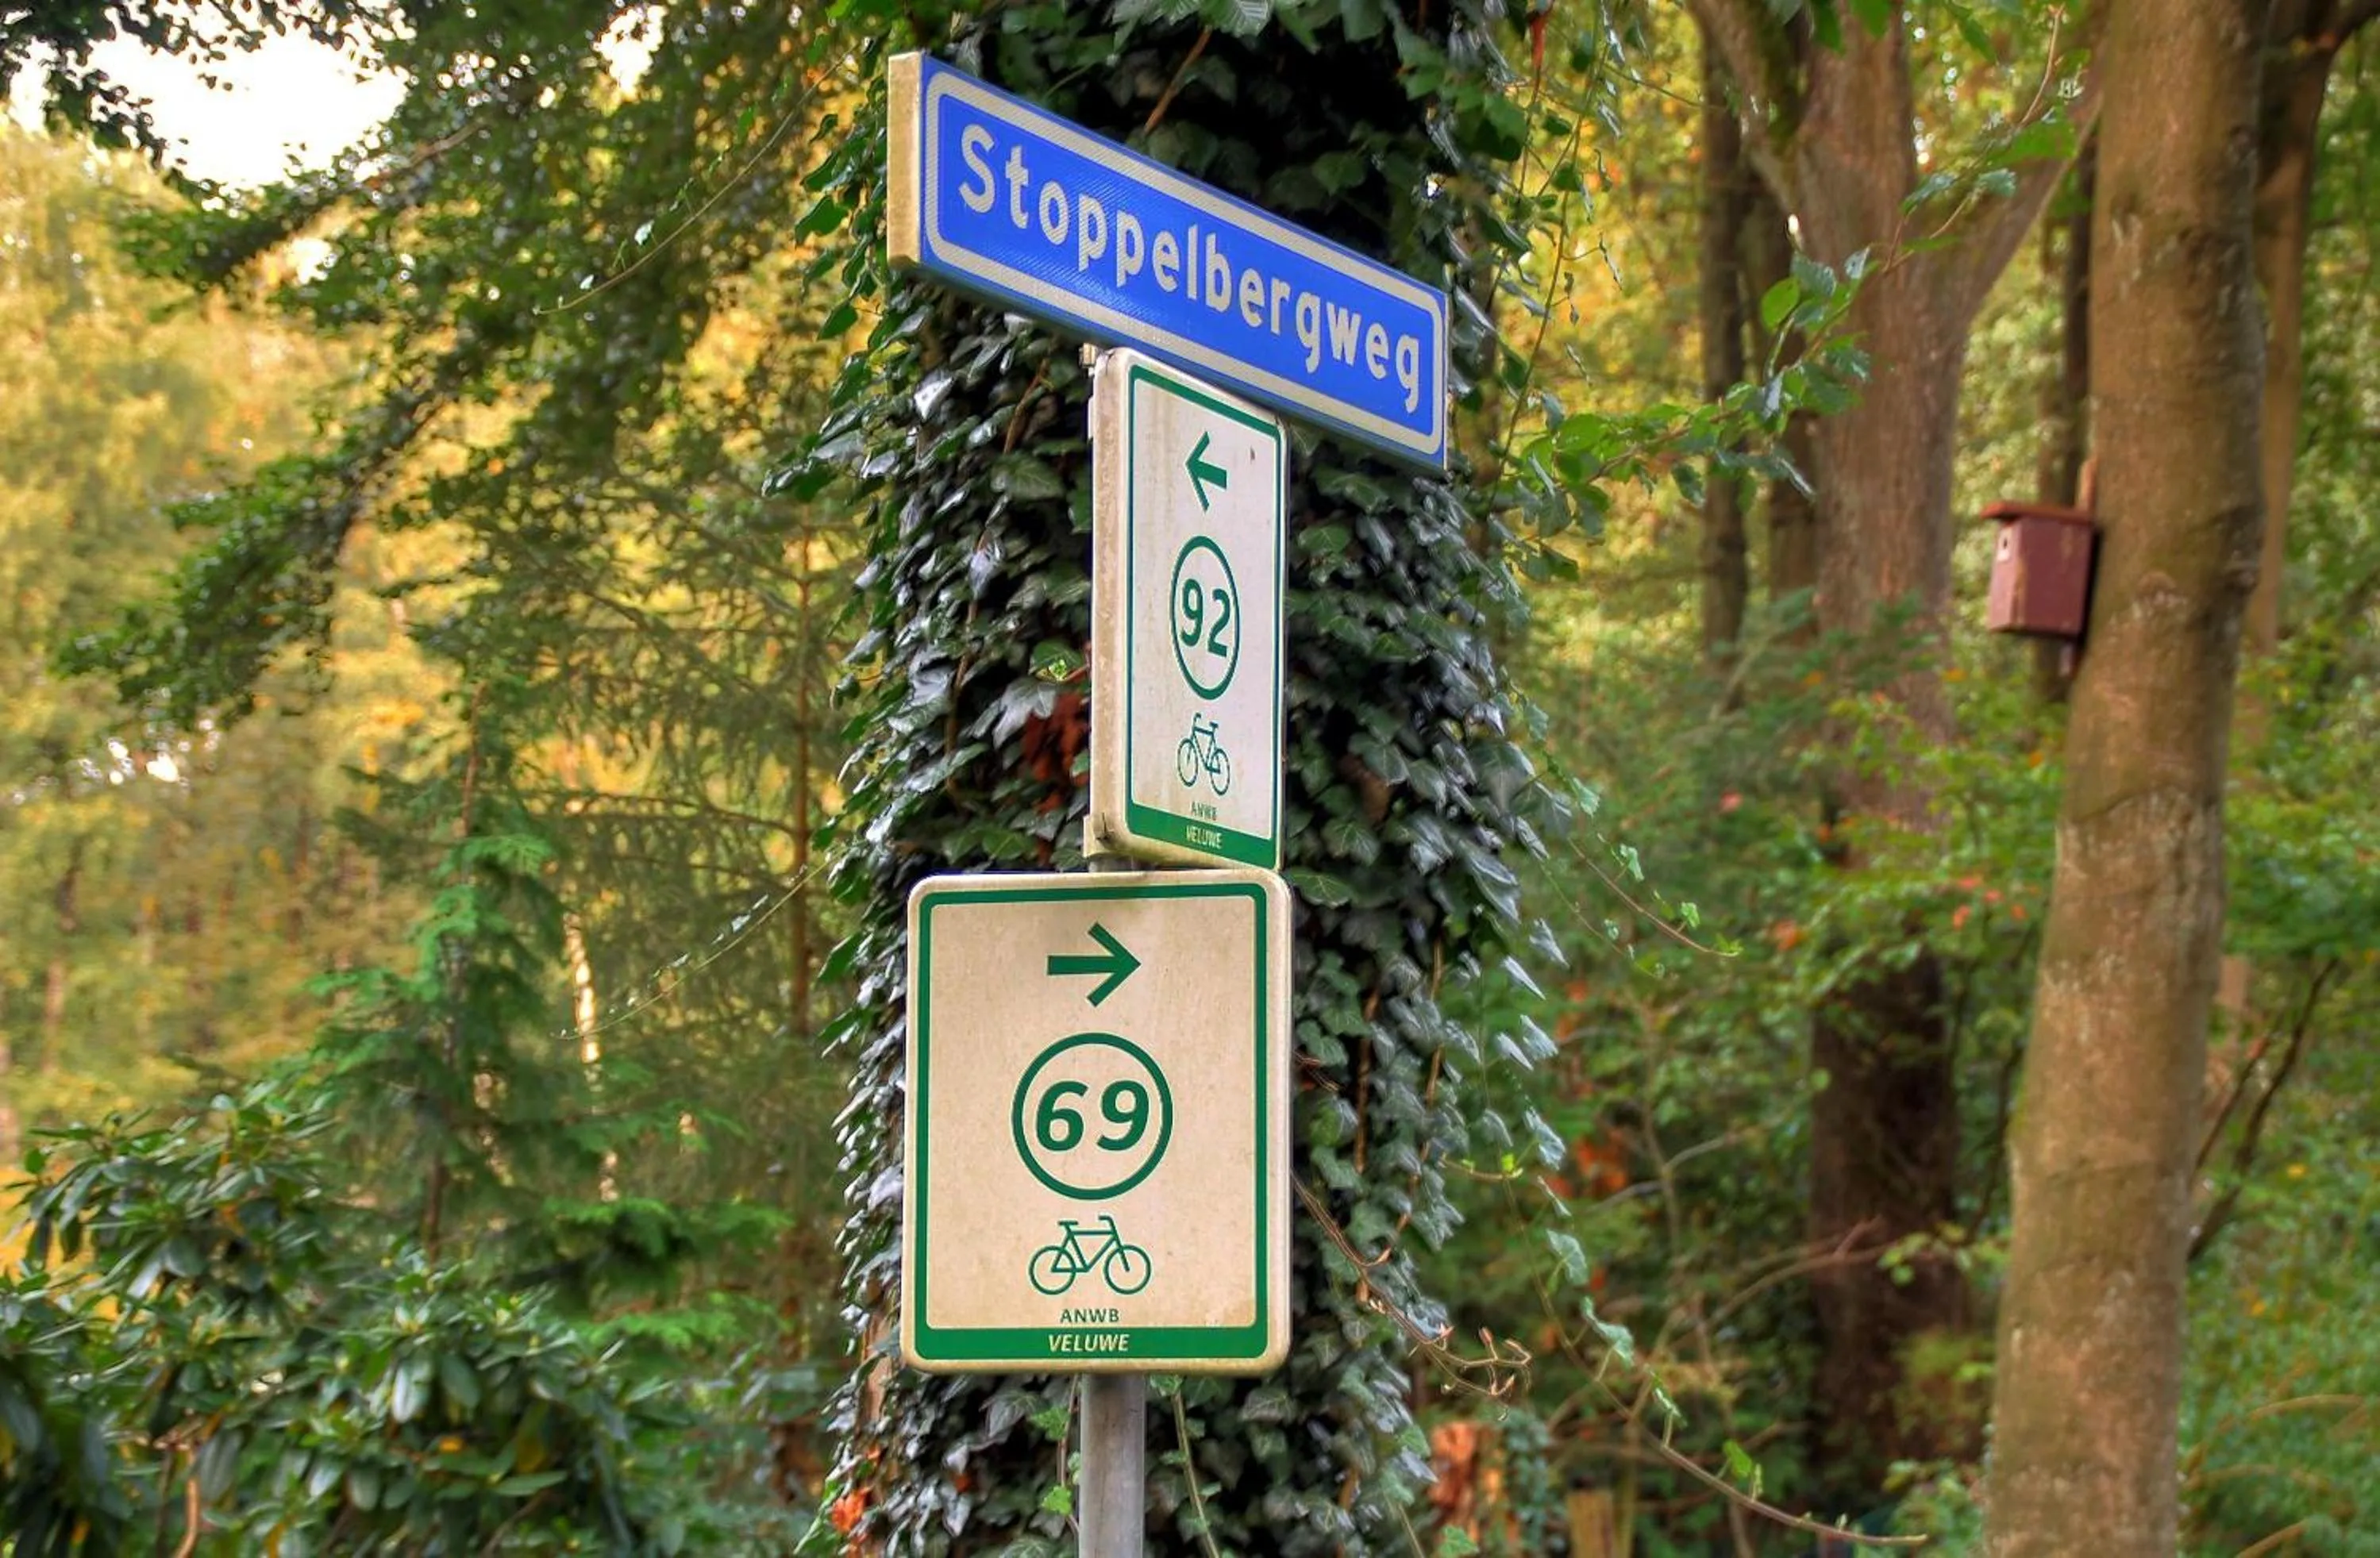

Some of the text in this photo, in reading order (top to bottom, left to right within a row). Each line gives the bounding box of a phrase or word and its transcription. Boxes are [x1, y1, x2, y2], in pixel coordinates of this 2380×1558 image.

[959, 124, 1419, 414] Stoppelbergweg
[1180, 578, 1230, 658] 92
[1036, 1080, 1150, 1151] 69
[1048, 1333, 1130, 1352] VELUWE
[1060, 1308, 1119, 1323] ANWB
